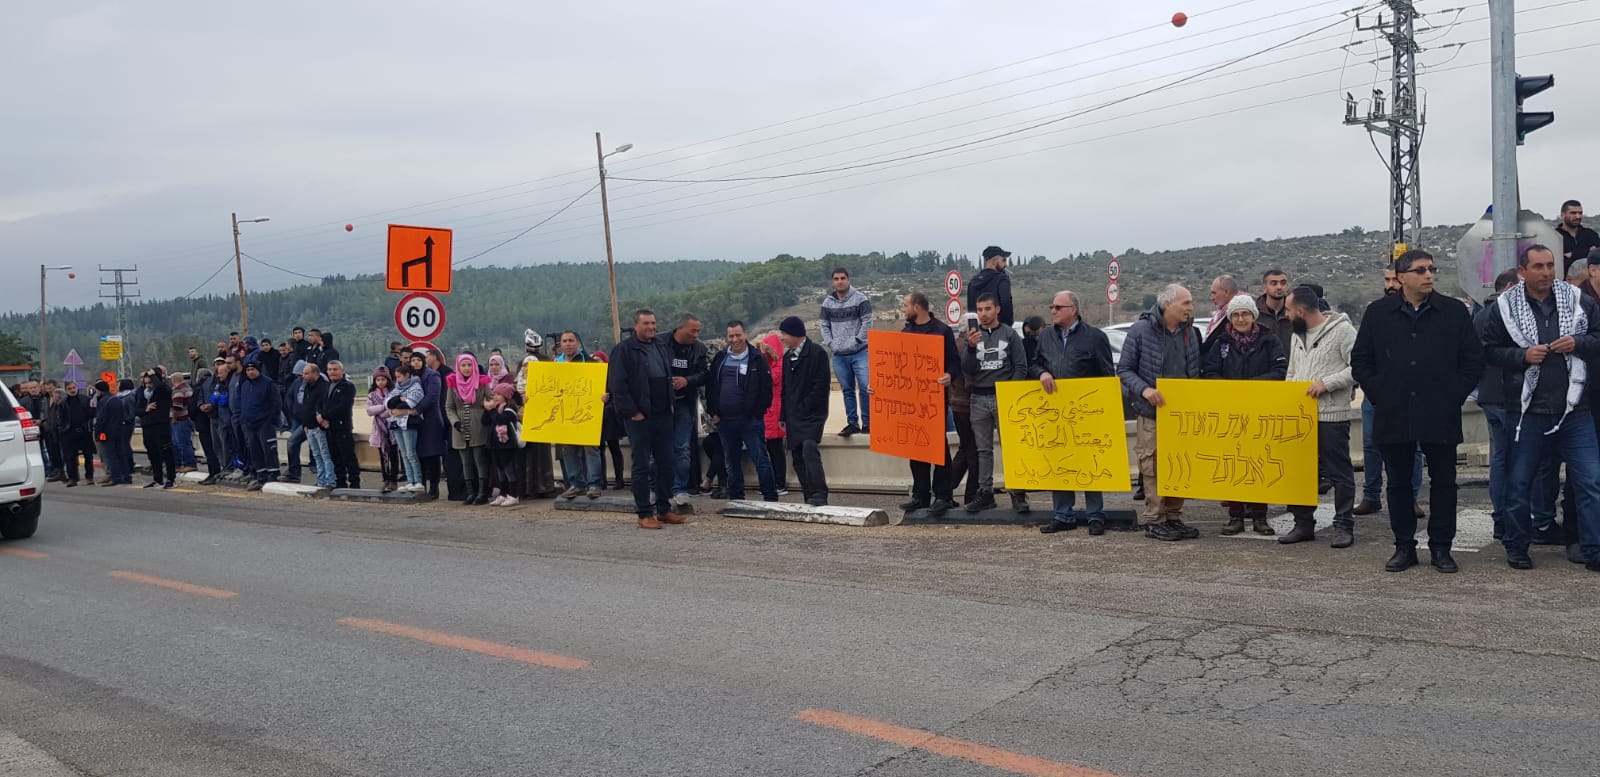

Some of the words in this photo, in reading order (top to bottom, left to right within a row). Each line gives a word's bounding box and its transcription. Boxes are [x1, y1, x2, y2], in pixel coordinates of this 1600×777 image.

[1110, 266, 1117, 277] 50
[949, 278, 958, 290] 50
[406, 306, 436, 328] 60
[876, 369, 913, 391] מלחמה
[874, 397, 917, 421] מנתקים
[917, 395, 938, 420] לא
[1169, 411, 1220, 438] האתר
[1217, 412, 1250, 439] את
[1253, 403, 1314, 444] לבנות
